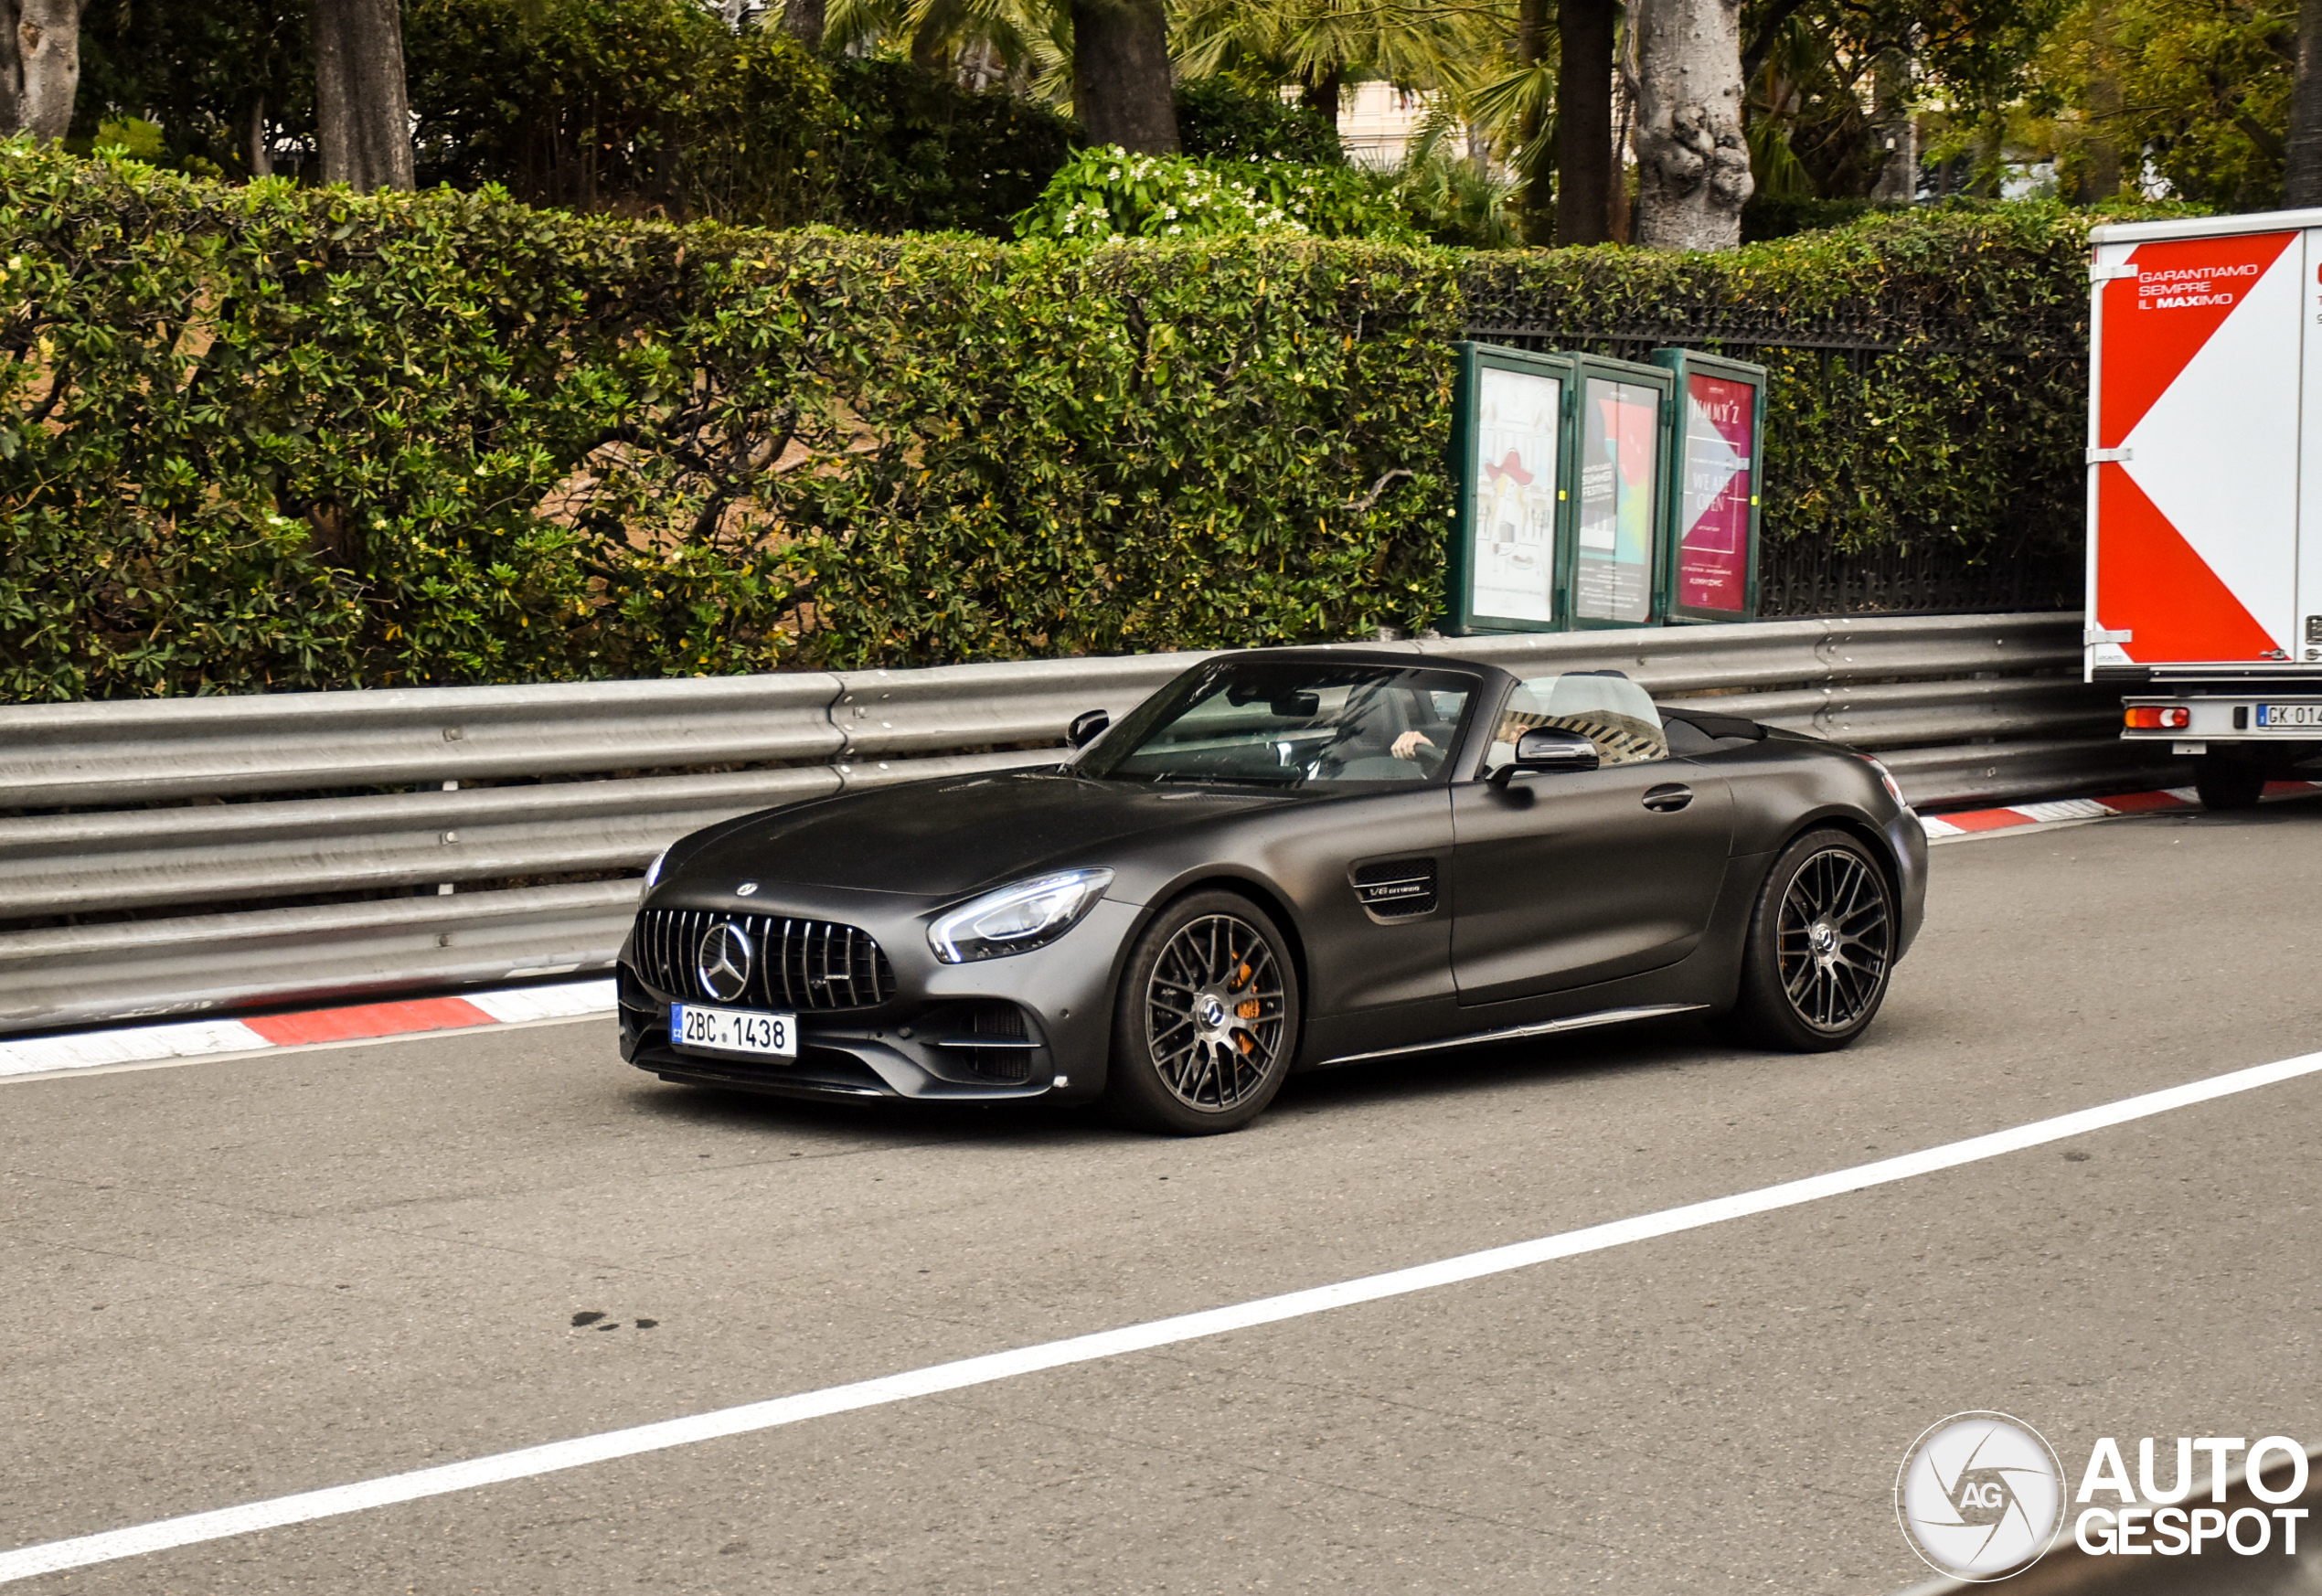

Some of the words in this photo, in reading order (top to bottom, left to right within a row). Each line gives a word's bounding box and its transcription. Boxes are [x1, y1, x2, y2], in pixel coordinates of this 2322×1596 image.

[2138, 264, 2258, 283] GARANTIAMO
[2138, 282, 2211, 296] SEMPRE
[2138, 300, 2153, 309] IL
[2157, 293, 2233, 308] MAXIMO
[1693, 472, 1710, 491] WE
[2269, 707, 2287, 724] GK
[1369, 888, 1389, 896] V8
[673, 1029, 682, 1038] CZ
[686, 1011, 717, 1043] 2BC
[733, 1016, 785, 1049] 1438
